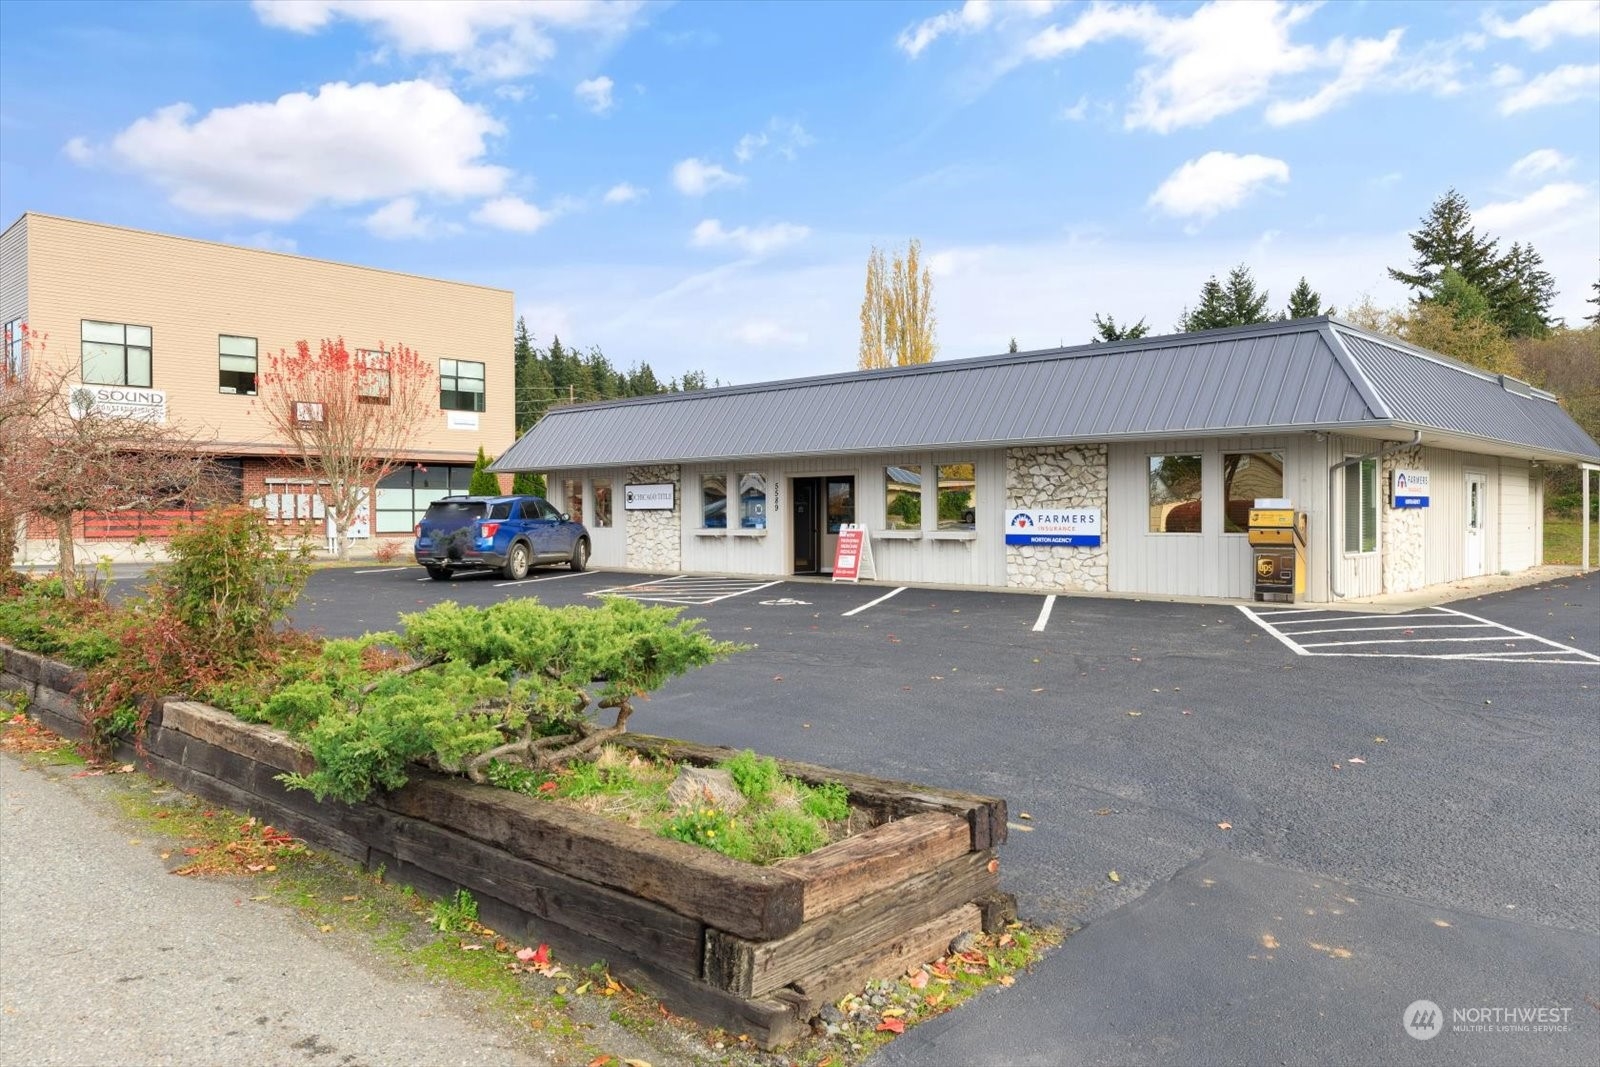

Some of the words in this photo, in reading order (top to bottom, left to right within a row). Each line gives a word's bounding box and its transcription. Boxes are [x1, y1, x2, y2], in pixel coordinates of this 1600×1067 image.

[97, 389, 163, 404] SOUND
[1407, 475, 1428, 485] FARMERS
[657, 492, 672, 500] TITLE
[1038, 514, 1095, 524] FARMERS
[1259, 564, 1272, 574] ups
